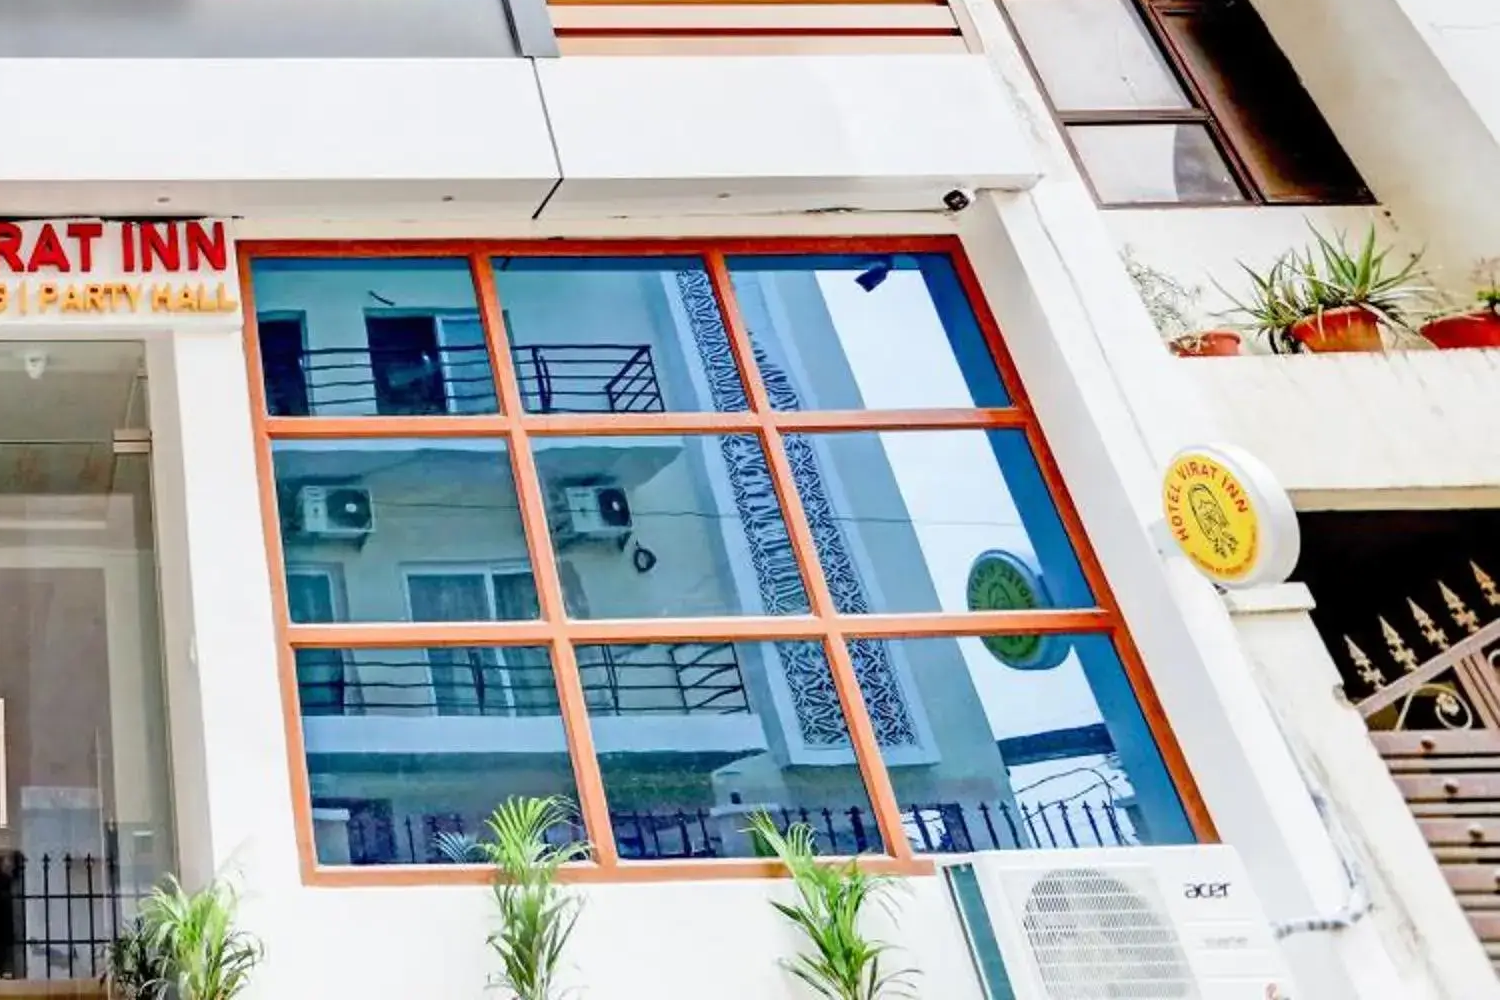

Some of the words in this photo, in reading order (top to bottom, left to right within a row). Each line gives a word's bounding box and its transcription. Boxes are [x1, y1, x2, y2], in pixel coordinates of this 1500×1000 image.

[121, 219, 227, 272] INN
[38, 281, 142, 314] PARTY
[151, 281, 238, 314] HALL
[1176, 461, 1218, 481] VIRAT
[1167, 483, 1189, 541] HOTEL
[1183, 882, 1232, 899] acer
